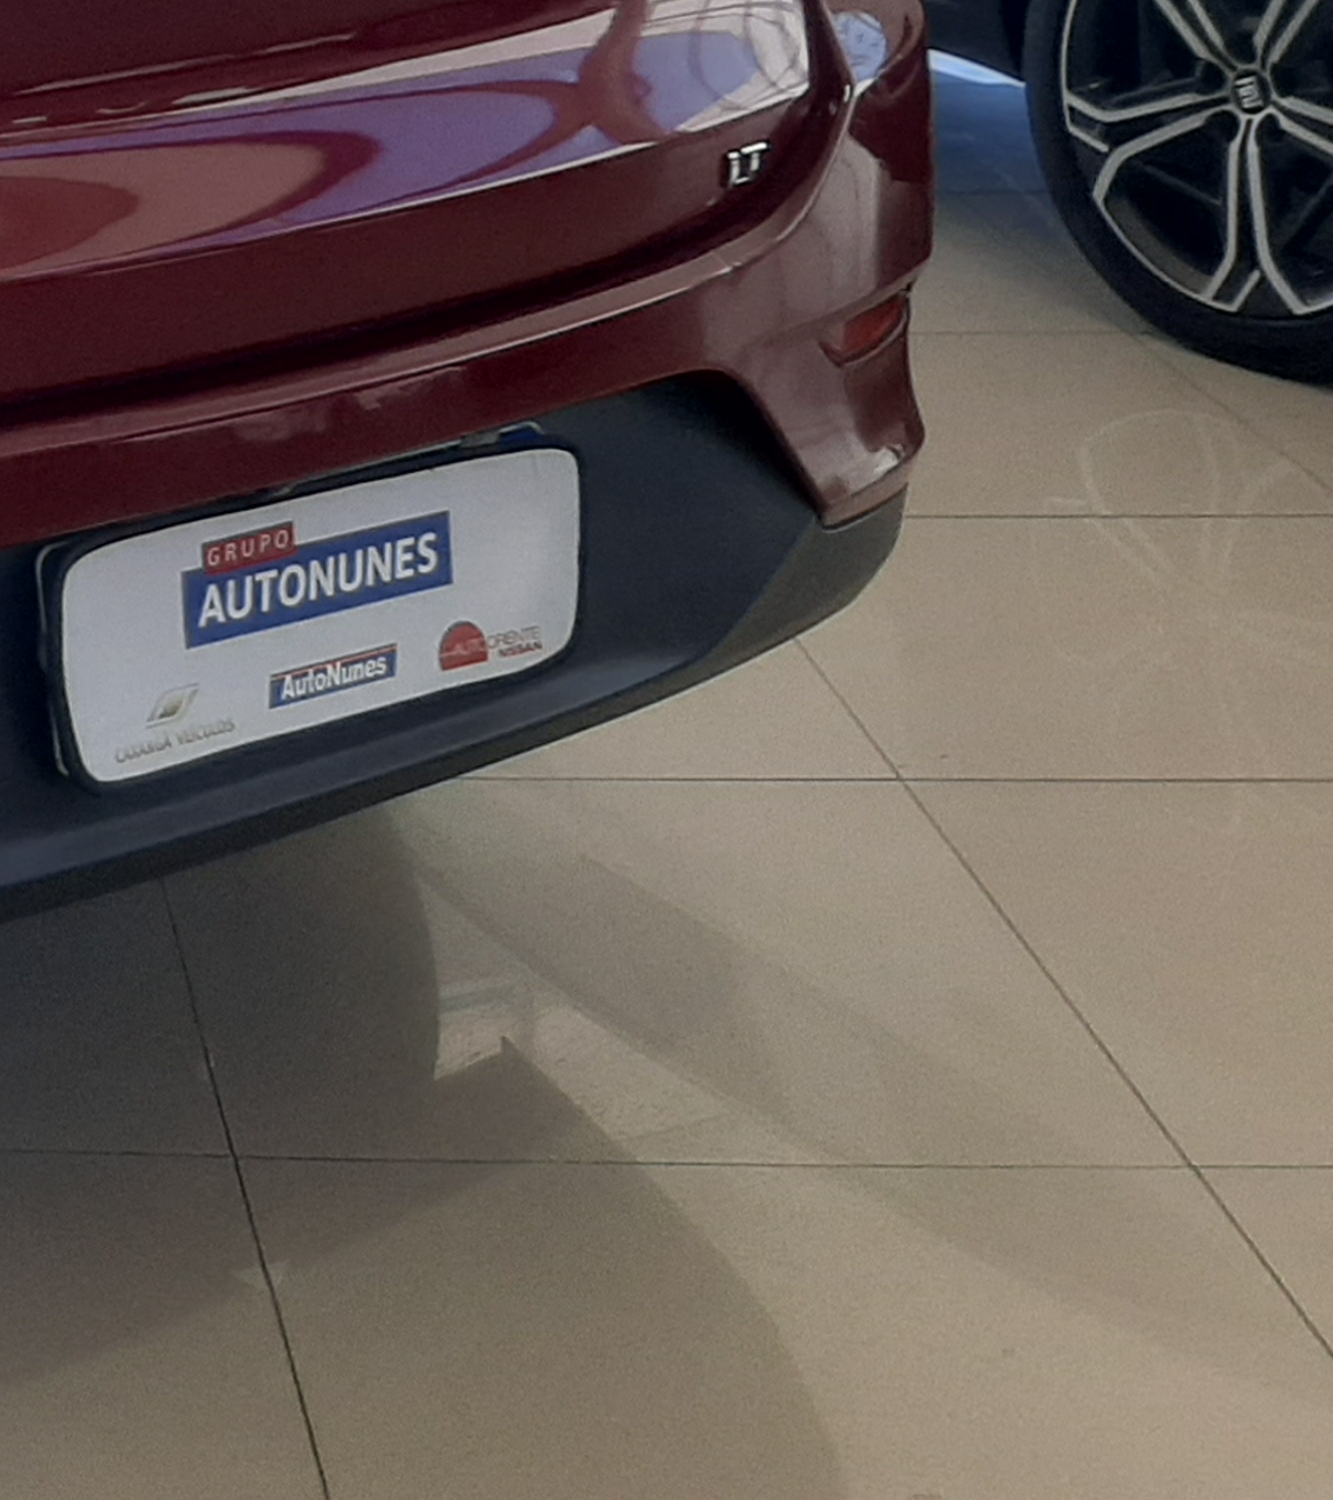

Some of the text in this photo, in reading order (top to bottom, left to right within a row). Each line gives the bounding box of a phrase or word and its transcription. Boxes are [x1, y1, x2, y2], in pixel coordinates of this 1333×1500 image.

[727, 141, 768, 188] LT
[205, 528, 291, 568] GRUPO
[197, 531, 439, 629] AUTONUNES
[281, 655, 388, 702] AutoNunes
